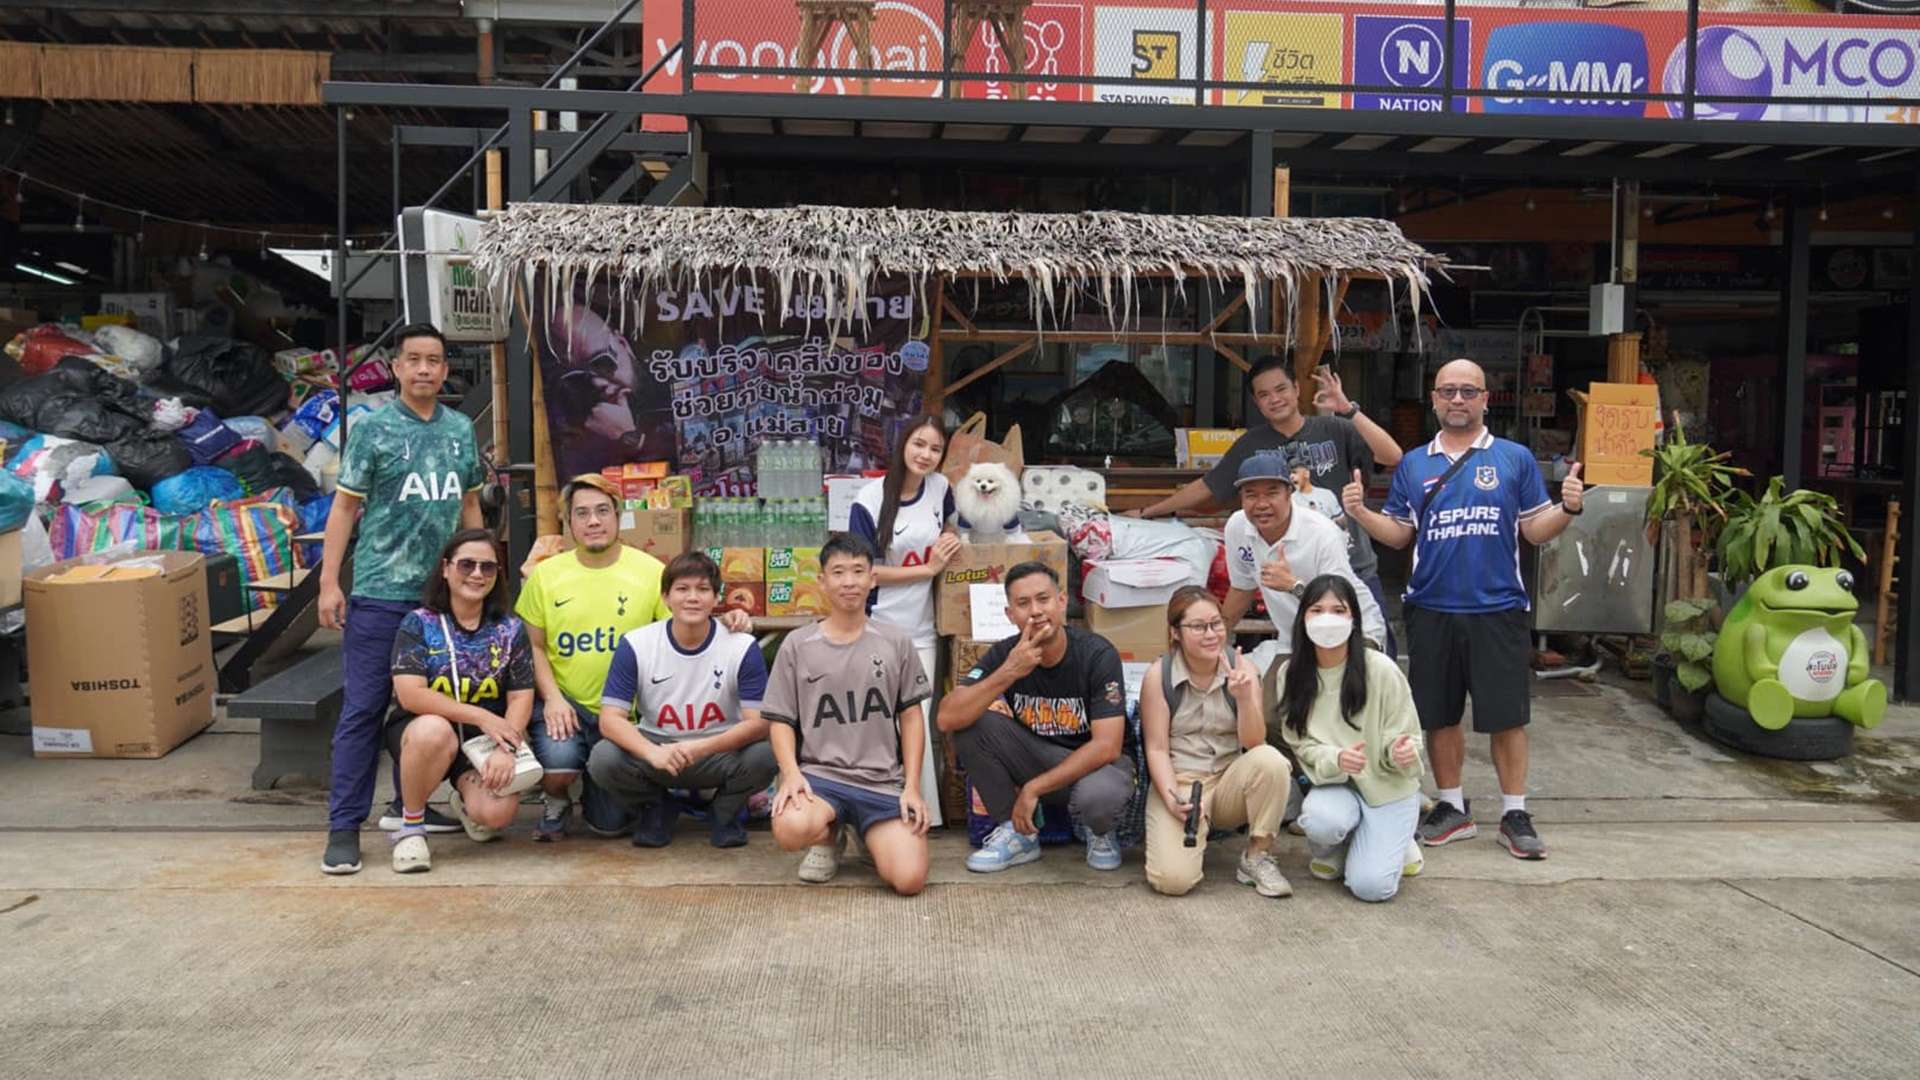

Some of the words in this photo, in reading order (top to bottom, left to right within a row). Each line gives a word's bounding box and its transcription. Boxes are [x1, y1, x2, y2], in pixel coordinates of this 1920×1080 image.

[1783, 38, 1920, 87] MCO
[1101, 94, 1170, 105] STARVING
[1380, 98, 1442, 112] NATION
[656, 287, 766, 321] SAVE
[650, 336, 902, 383] รับบริจาคสิ่งของ
[672, 374, 885, 420] ช่วยภัยน้ำท่วม
[399, 471, 462, 501] AIA
[1438, 506, 1501, 524] SPURS
[902, 546, 932, 567] AI
[70, 678, 141, 692] TOSHIBA
[429, 675, 499, 703] AIA
[656, 702, 726, 731] AIA
[813, 687, 892, 728] AIA
